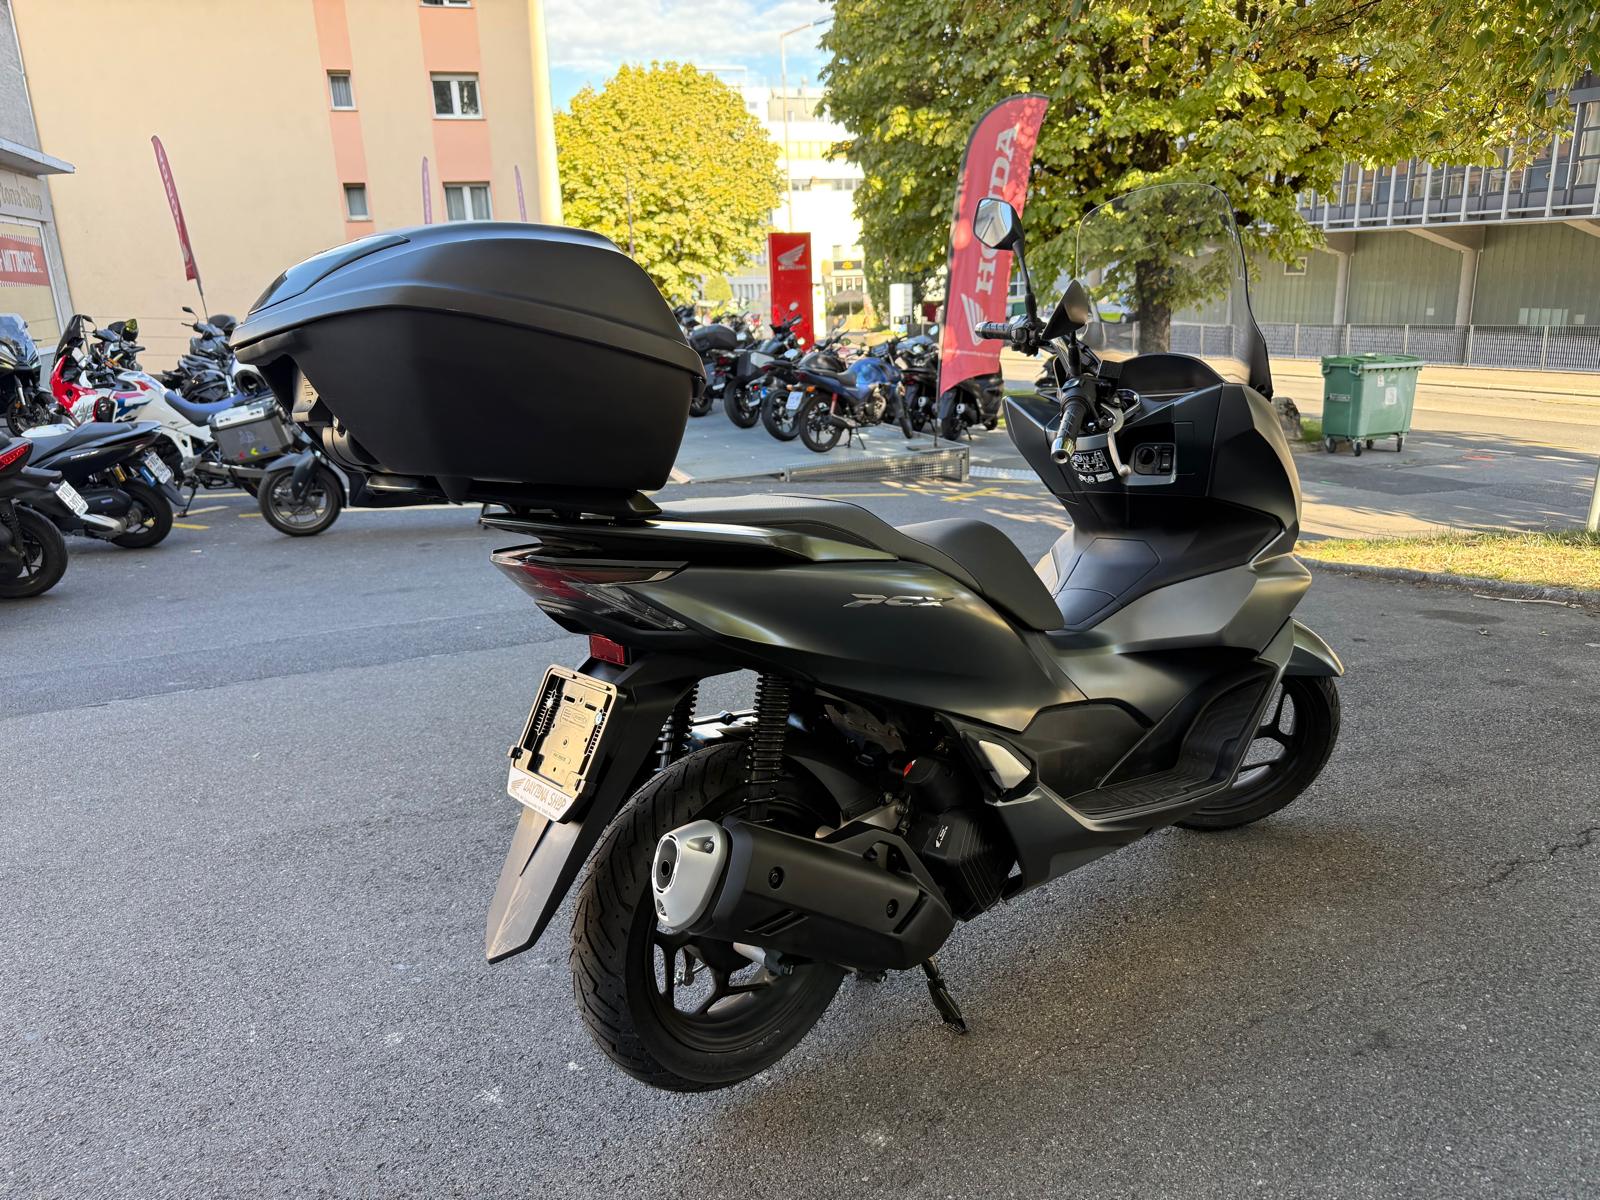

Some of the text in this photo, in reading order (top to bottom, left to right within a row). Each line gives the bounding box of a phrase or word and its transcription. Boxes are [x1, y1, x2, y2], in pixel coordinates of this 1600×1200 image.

[976, 123, 1019, 295] HDA
[842, 593, 954, 608] PCX
[523, 779, 550, 804] DAYTONA
[548, 792, 567, 811] SHOP
